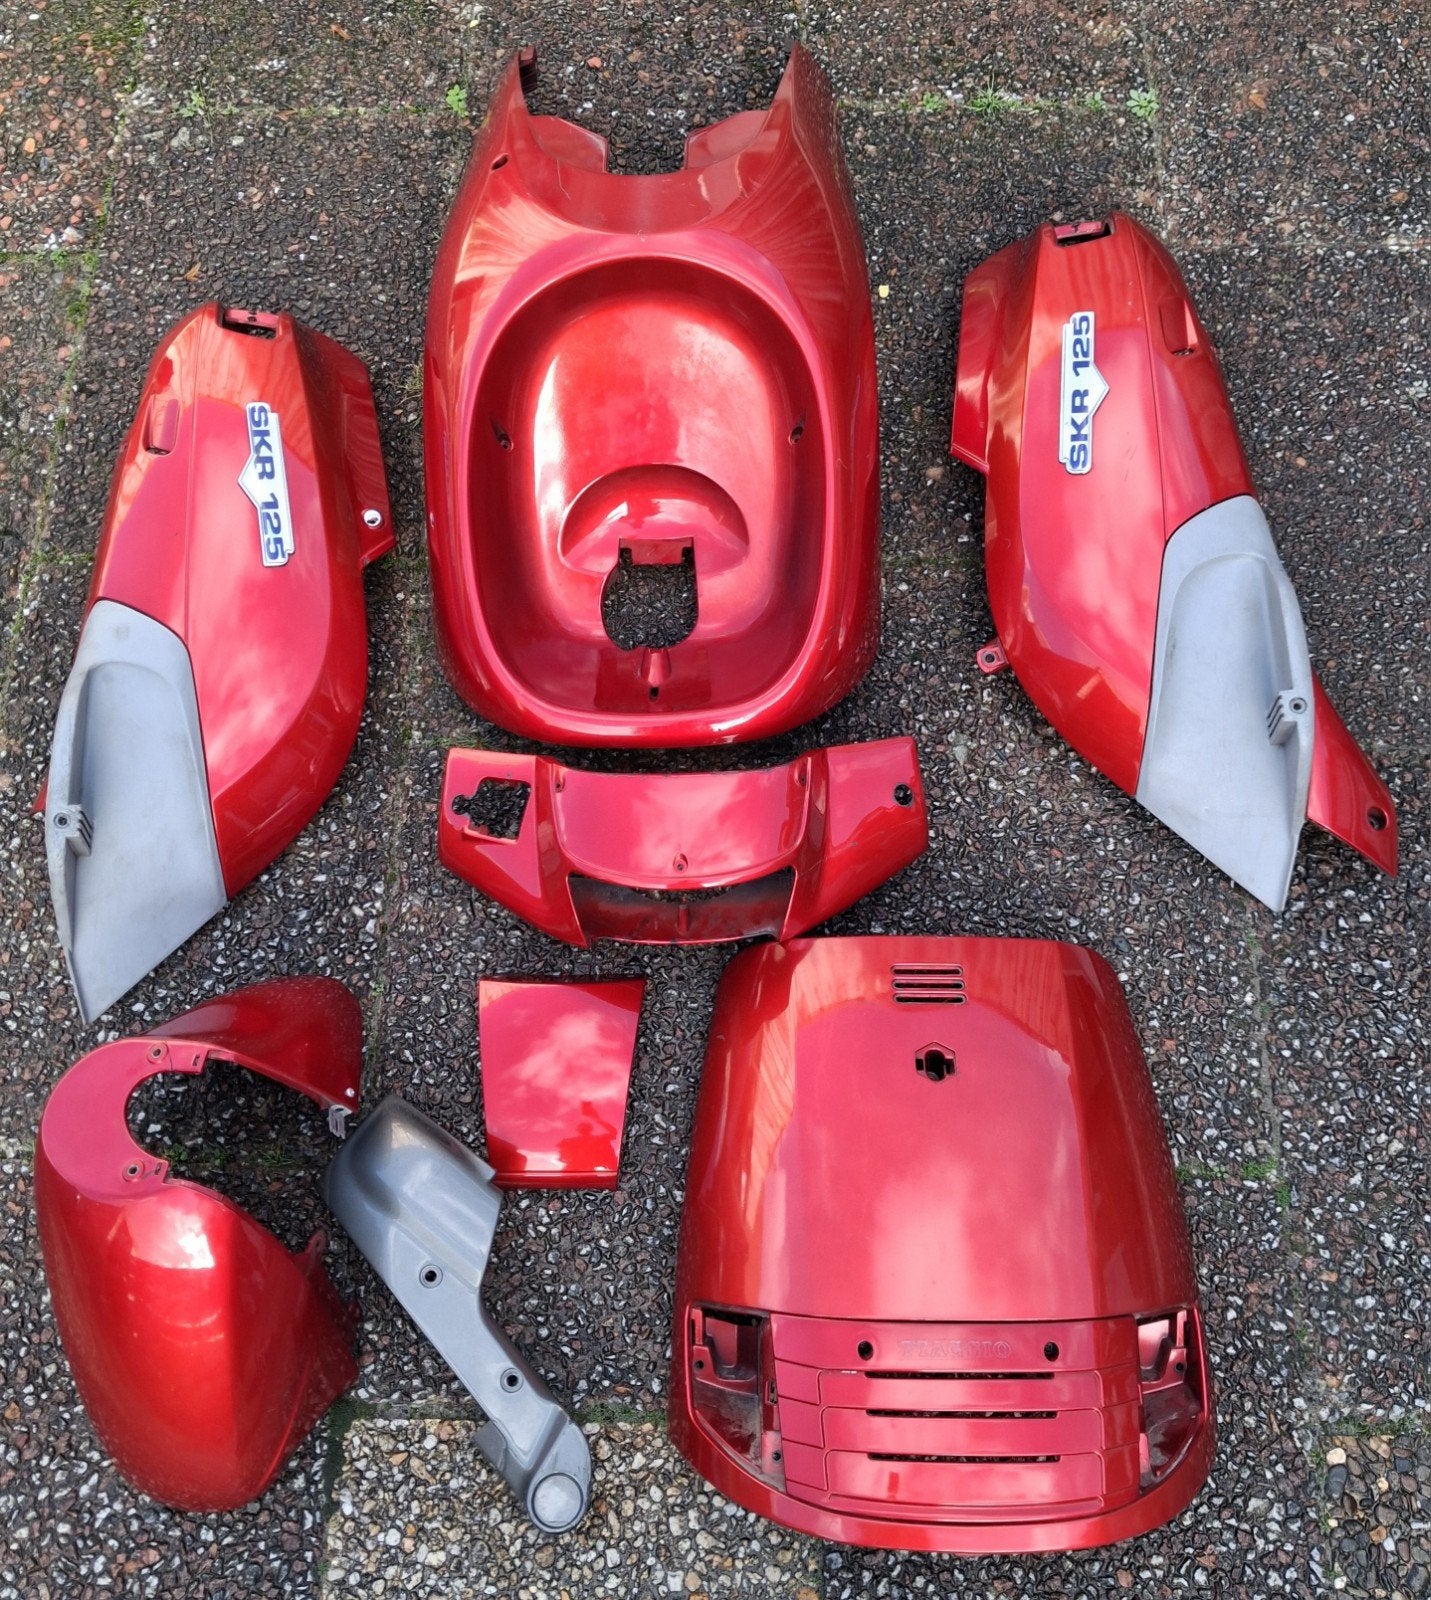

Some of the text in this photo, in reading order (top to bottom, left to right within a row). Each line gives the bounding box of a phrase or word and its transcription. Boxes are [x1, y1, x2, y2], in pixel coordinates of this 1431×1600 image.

[1070, 315, 1090, 469] SKR 125
[250, 405, 286, 560] SKR 125
